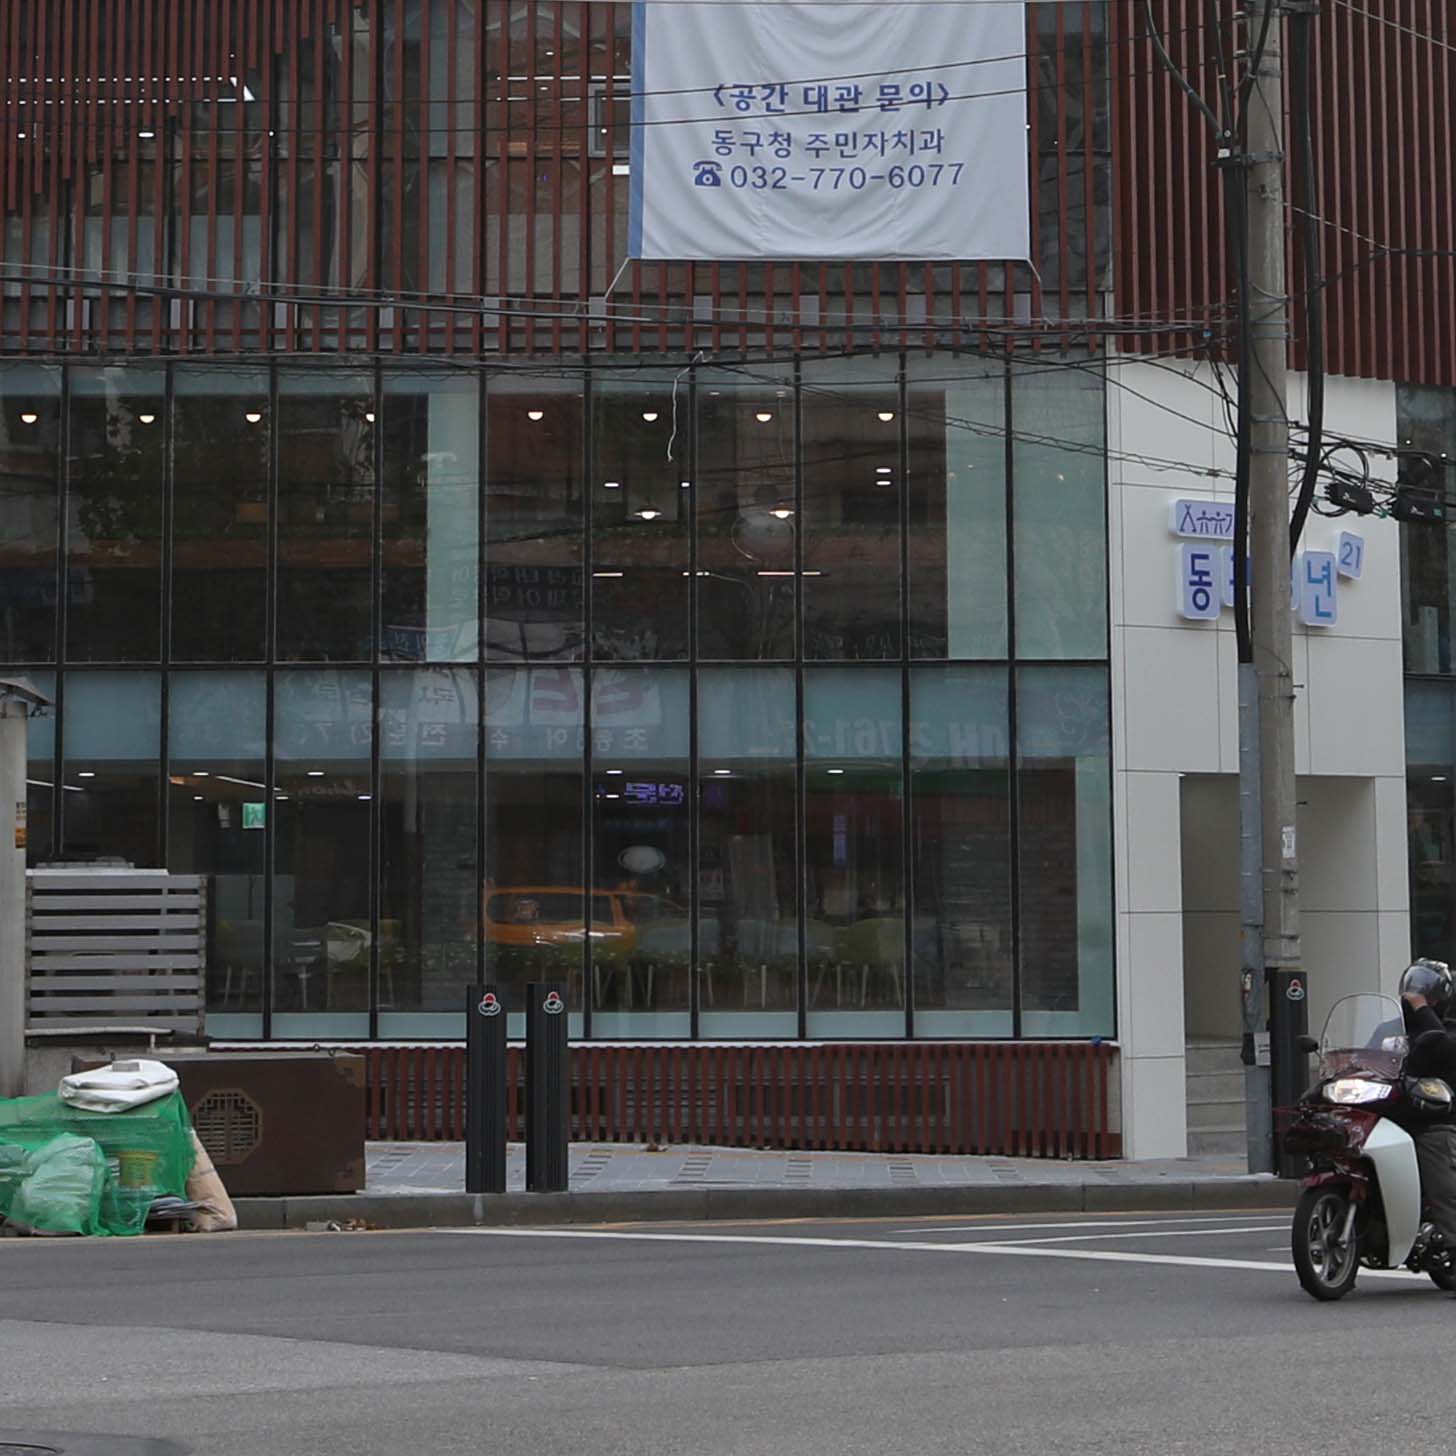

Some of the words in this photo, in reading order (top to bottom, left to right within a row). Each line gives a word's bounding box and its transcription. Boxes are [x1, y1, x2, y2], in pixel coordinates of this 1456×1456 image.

[802, 83, 864, 114] 대관
[711, 129, 793, 159] 동구청
[803, 128, 946, 158] 주민자치과
[729, 161, 966, 191] 032-770-6077
[1341, 541, 1363, 570] 21
